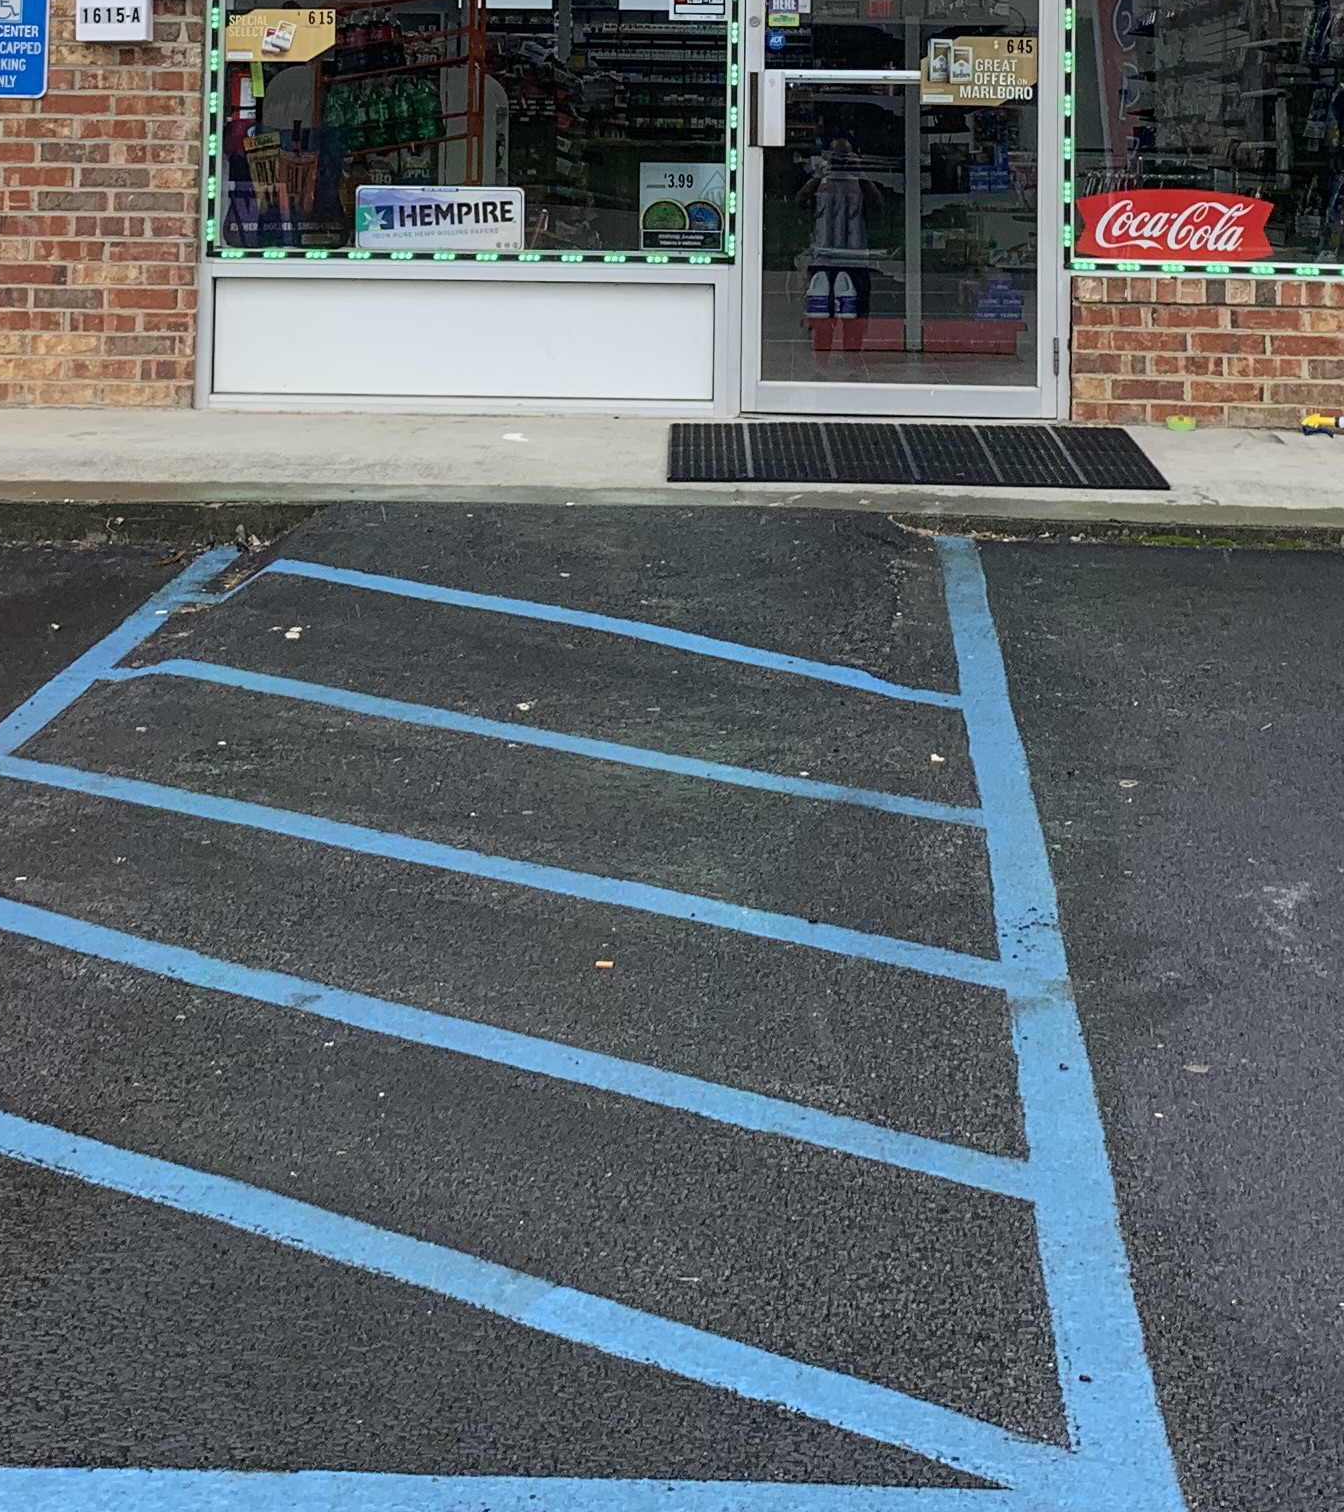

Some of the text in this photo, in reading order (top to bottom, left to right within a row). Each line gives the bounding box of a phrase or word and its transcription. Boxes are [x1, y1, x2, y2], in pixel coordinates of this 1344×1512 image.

[83, 7, 141, 24] 1615-A
[229, 14, 269, 26] SPECIAL
[974, 58, 1018, 72] GREAT
[974, 73, 1016, 86] OFFER
[959, 85, 1033, 100] MARLBORO
[398, 201, 515, 228] HEMPIRE
[437, 228, 470, 237] ROLLING
[470, 227, 499, 235] PAPERS
[1095, 199, 1255, 252] Coca-Cola
